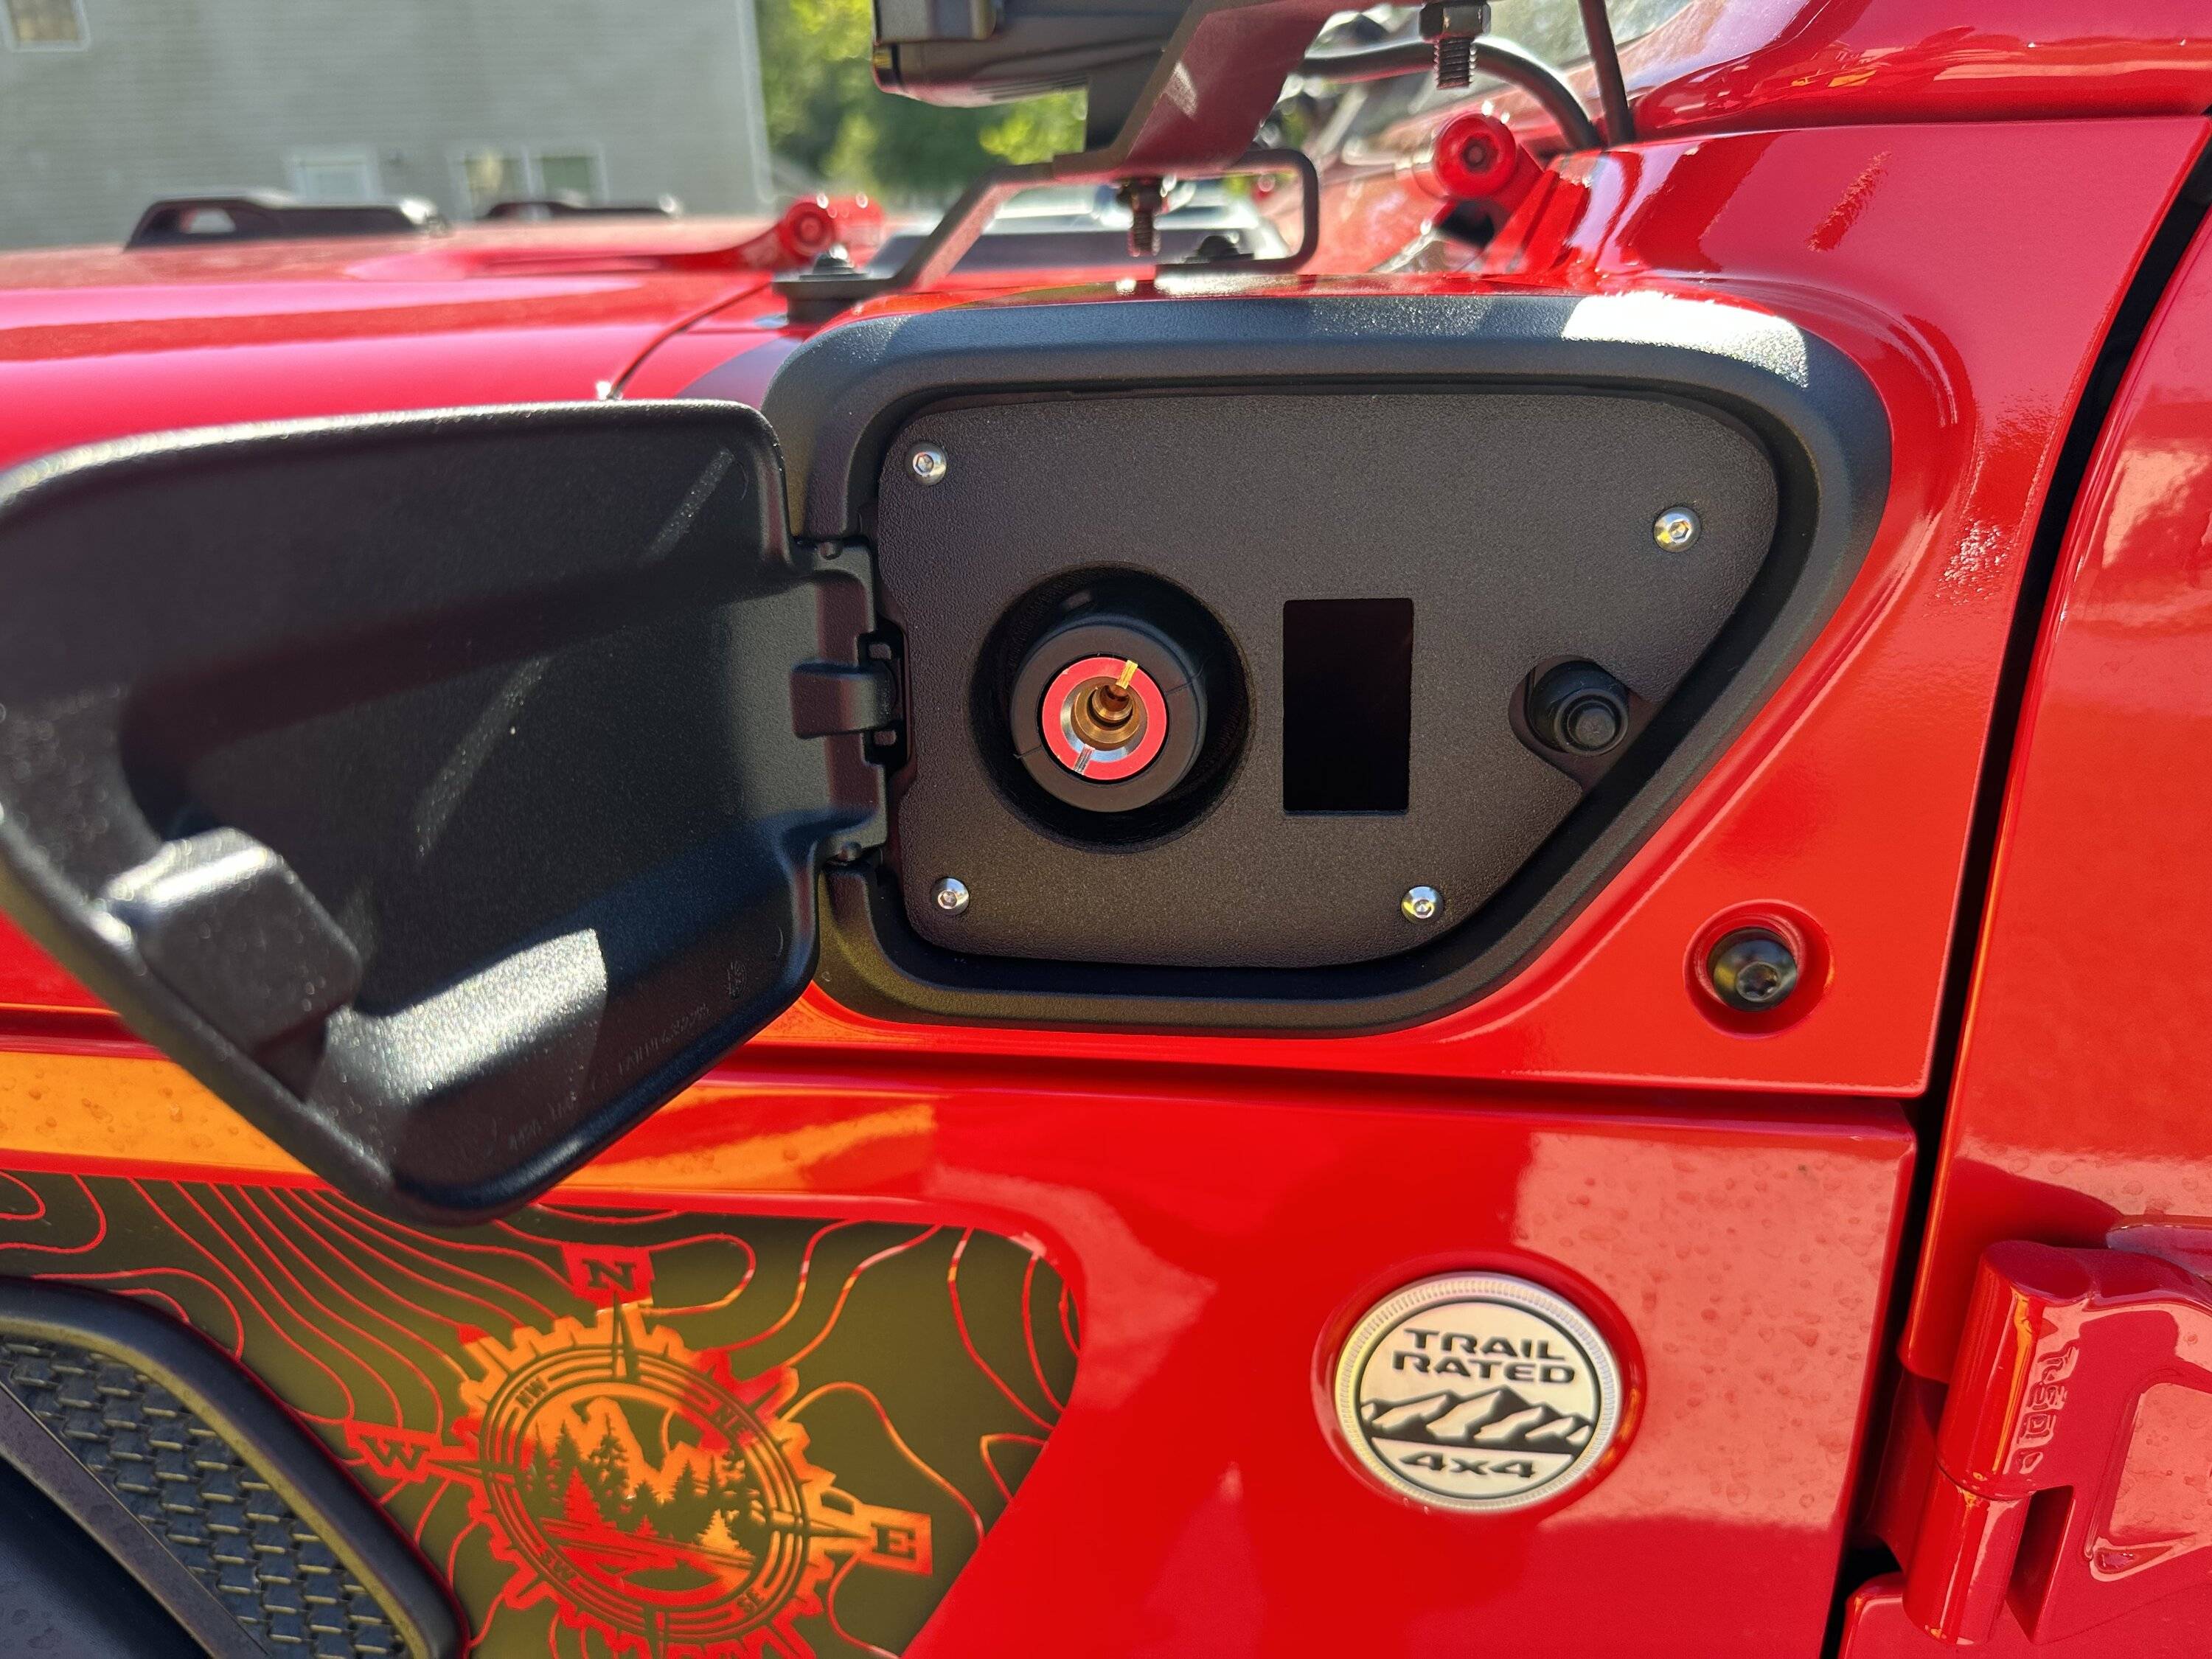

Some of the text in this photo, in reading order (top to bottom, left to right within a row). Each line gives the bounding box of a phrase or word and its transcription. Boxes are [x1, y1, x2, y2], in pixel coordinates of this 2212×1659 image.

[582, 1258, 636, 1291] N
[1403, 1327, 1565, 1361] TRAIL
[1392, 1350, 1575, 1383] RATED
[359, 1434, 430, 1471] W
[870, 1522, 916, 1559] E
